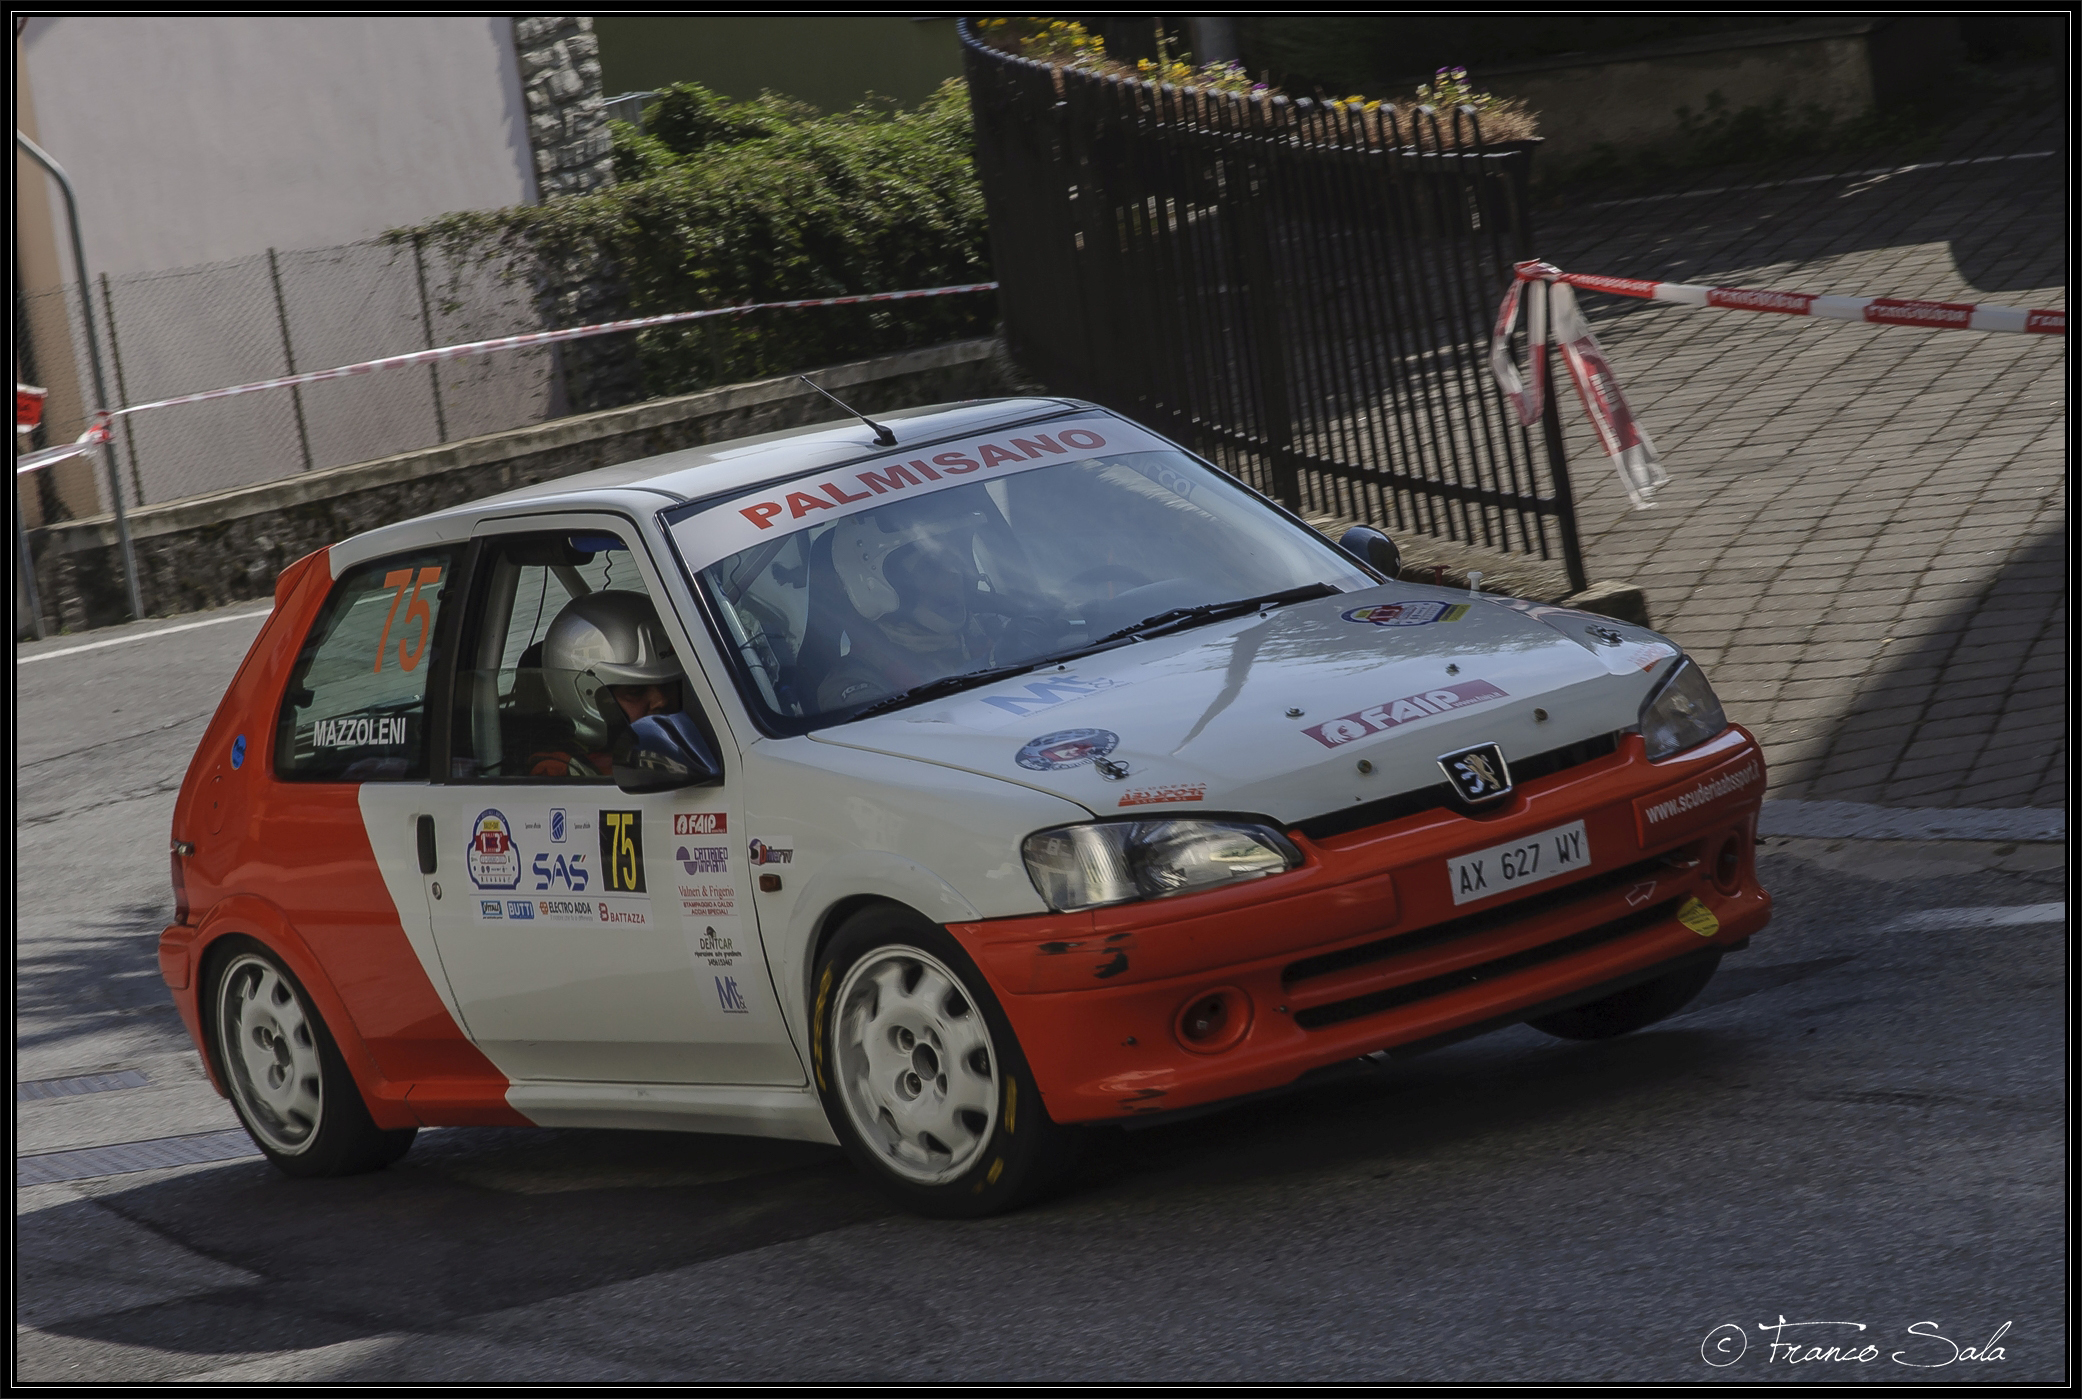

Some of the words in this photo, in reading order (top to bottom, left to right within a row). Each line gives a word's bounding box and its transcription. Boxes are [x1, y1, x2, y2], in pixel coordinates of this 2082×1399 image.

[739, 429, 1106, 530] PALMISANO
[374, 567, 442, 673] 75
[1360, 690, 1459, 730] FAIP
[313, 717, 406, 746] MAZZOLENI
[689, 814, 717, 834] FAIP
[607, 813, 637, 890] 75
[1459, 860, 1488, 894] AX
[1500, 843, 1541, 880] 627
[1555, 829, 1581, 864] WY
[533, 853, 589, 891] SAS
[709, 885, 734, 900] Frigerio
[508, 903, 534, 916] BUTTI
[548, 901, 574, 914] ELECTRO
[574, 902, 592, 914] ADDA
[610, 912, 646, 924] BATTAZZA
[699, 938, 733, 950] DENTCAR
